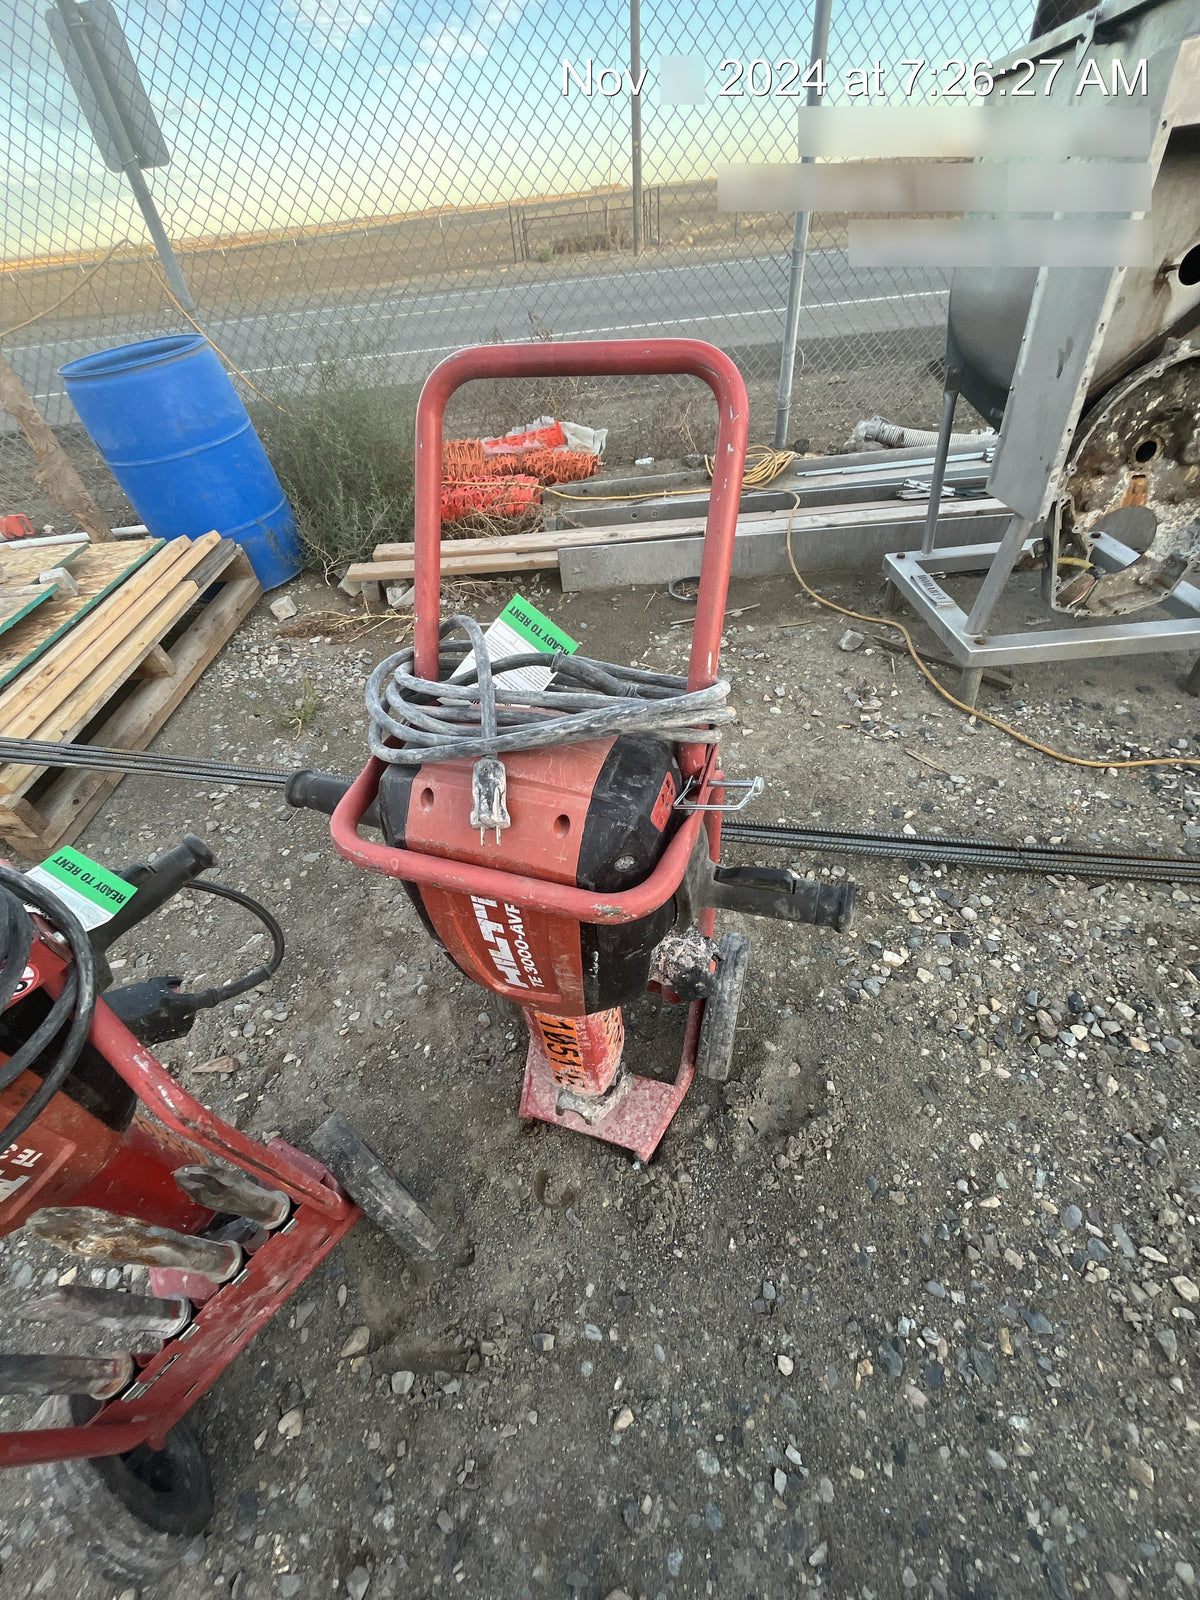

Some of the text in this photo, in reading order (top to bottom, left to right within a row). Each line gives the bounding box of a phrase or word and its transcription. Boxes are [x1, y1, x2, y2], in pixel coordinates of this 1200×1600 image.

[508, 606, 532, 627] RENT
[530, 624, 543, 637] TO
[52, 856, 127, 904] READY TO RENT
[470, 895, 530, 988] HILTI
[528, 975, 545, 988] TE
[10, 1148, 44, 1167] TE
